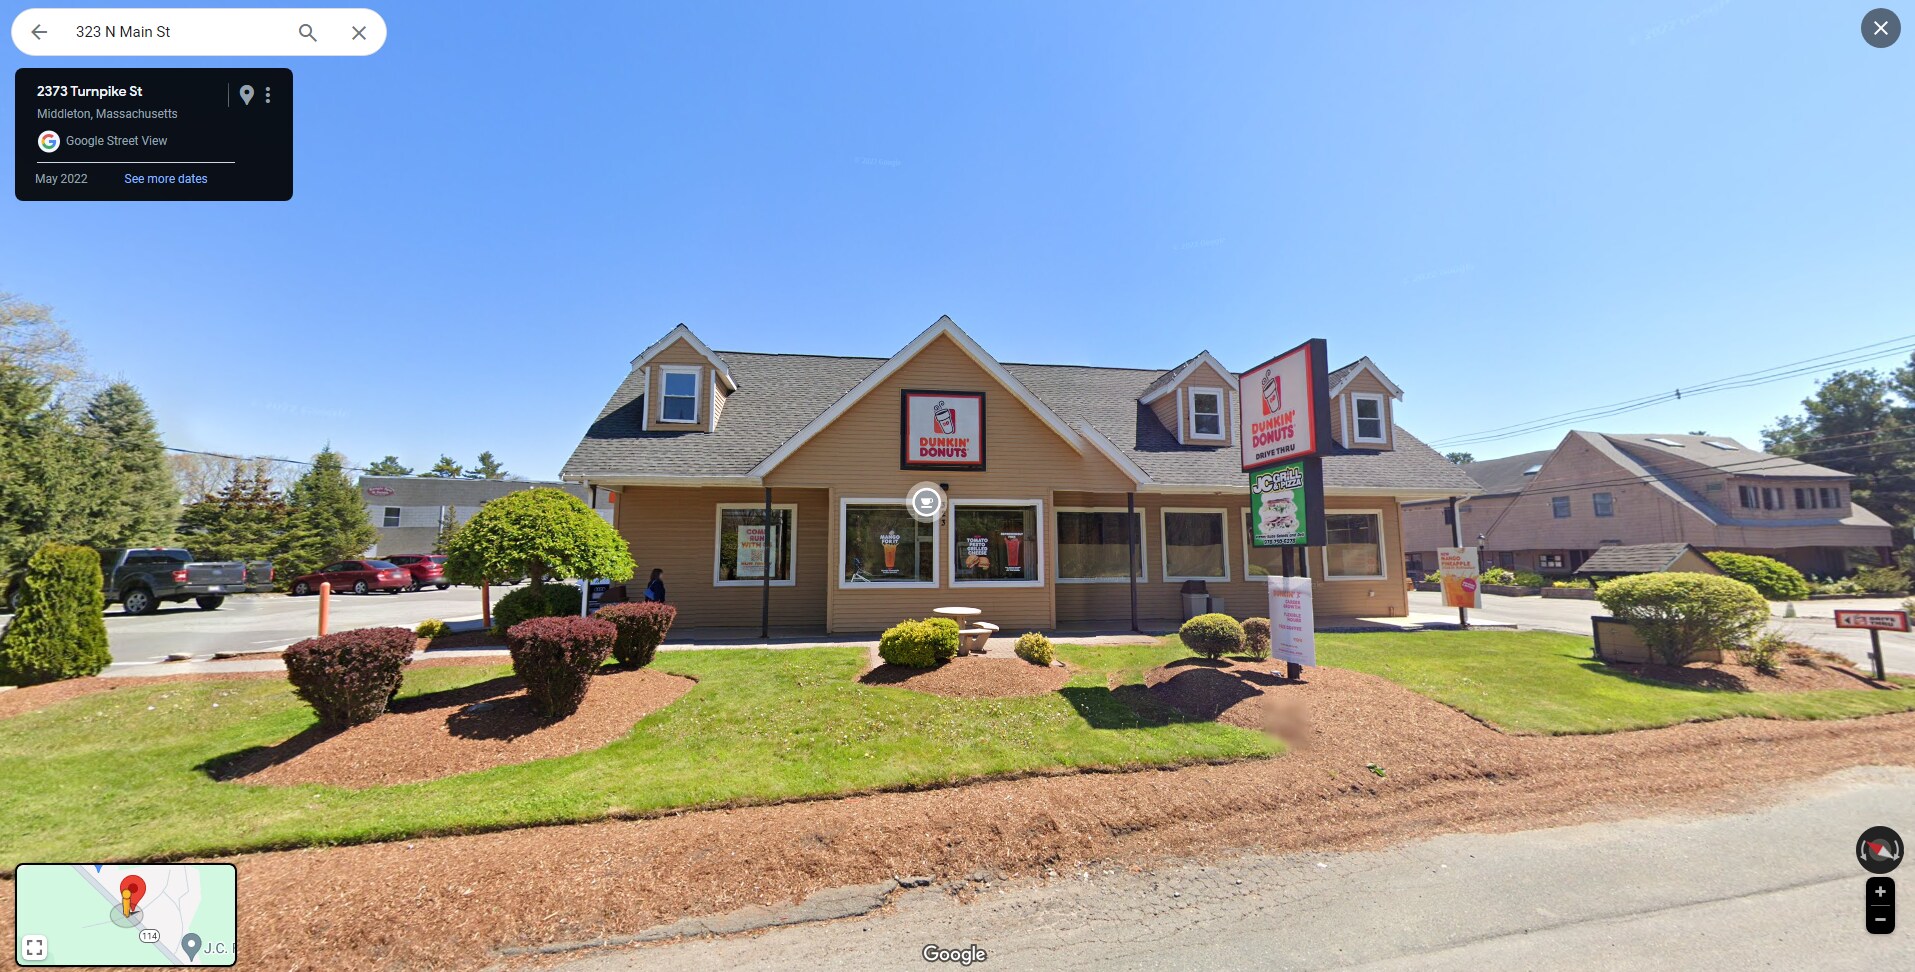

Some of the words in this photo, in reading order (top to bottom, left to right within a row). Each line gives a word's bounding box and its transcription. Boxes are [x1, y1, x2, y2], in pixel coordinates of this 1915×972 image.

[1252, 410, 1295, 435] DUNKIN'
[920, 437, 970, 447] DUNKIN'
[1252, 424, 1294, 448] DONUTS
[920, 448, 967, 458] DONUTS
[1255, 449, 1275, 460] DRIVE
[1276, 444, 1295, 454] THRU
[1253, 474, 1273, 494] JC
[1273, 481, 1279, 490] &
[1280, 479, 1301, 489] PIZZA
